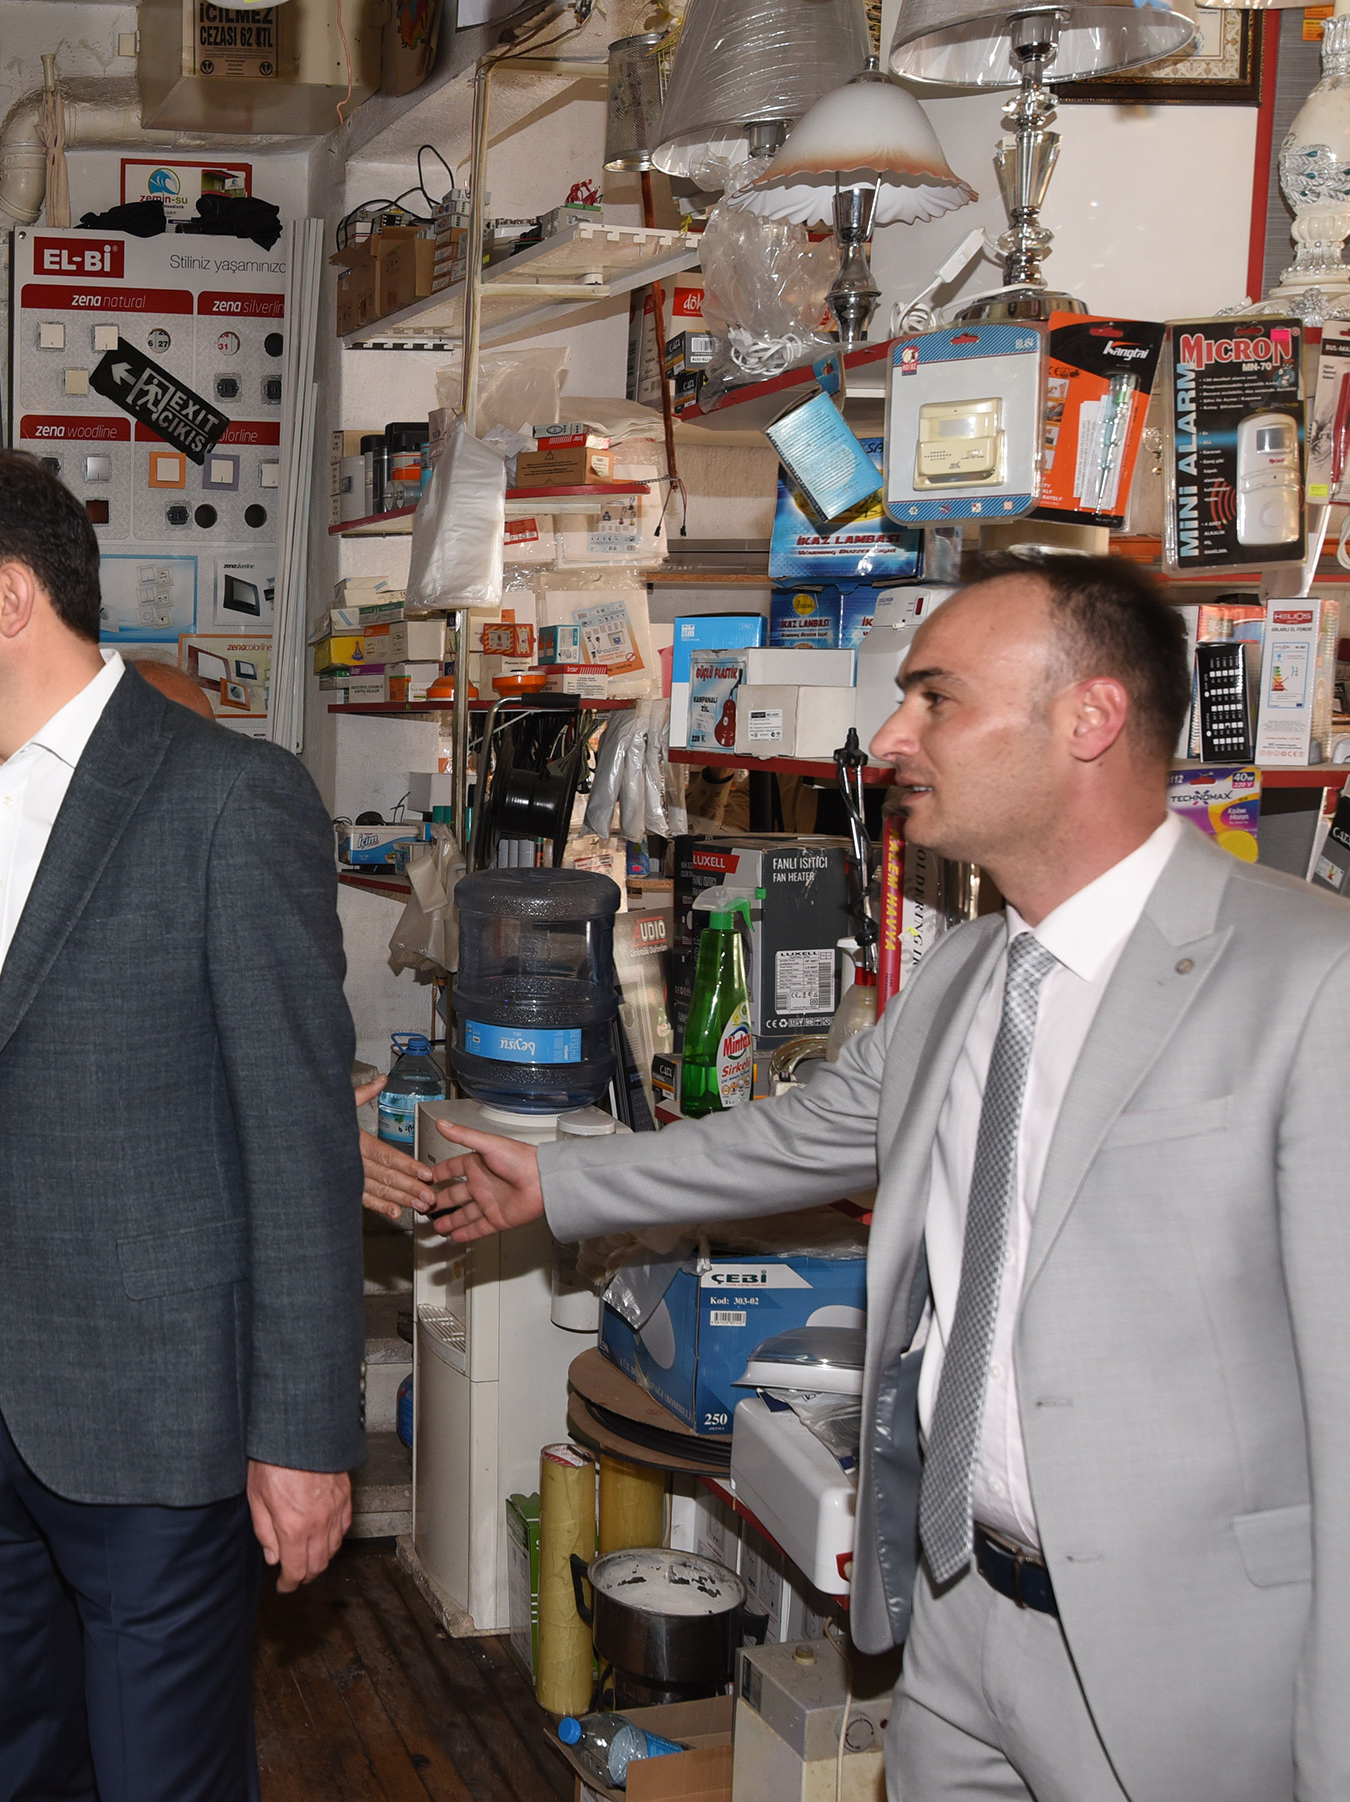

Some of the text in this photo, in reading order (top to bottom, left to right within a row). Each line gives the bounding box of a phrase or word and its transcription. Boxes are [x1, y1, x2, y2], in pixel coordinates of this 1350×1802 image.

[169, 254, 211, 271] Stiliniz
[71, 293, 147, 309] zena natural
[212, 299, 285, 316] zena silverlin
[1180, 333, 1292, 371] MICRON
[1242, 362, 1272, 372] MN-70
[173, 391, 220, 432] EXIT
[1176, 362, 1198, 476] ALARM
[35, 424, 118, 439] zena woodline
[797, 534, 900, 546] İKAZ LAMBASI
[693, 855, 726, 869] LUXELL
[772, 857, 797, 870] FANLI
[772, 872, 815, 883] FAN HEATER
[912, 849, 927, 949] OLDERING
[885, 893, 899, 951] HAVYA
[499, 1037, 536, 1056] beysu
[710, 1296, 760, 1306] Kod: 303-02
[703, 1412, 729, 1426] 250
